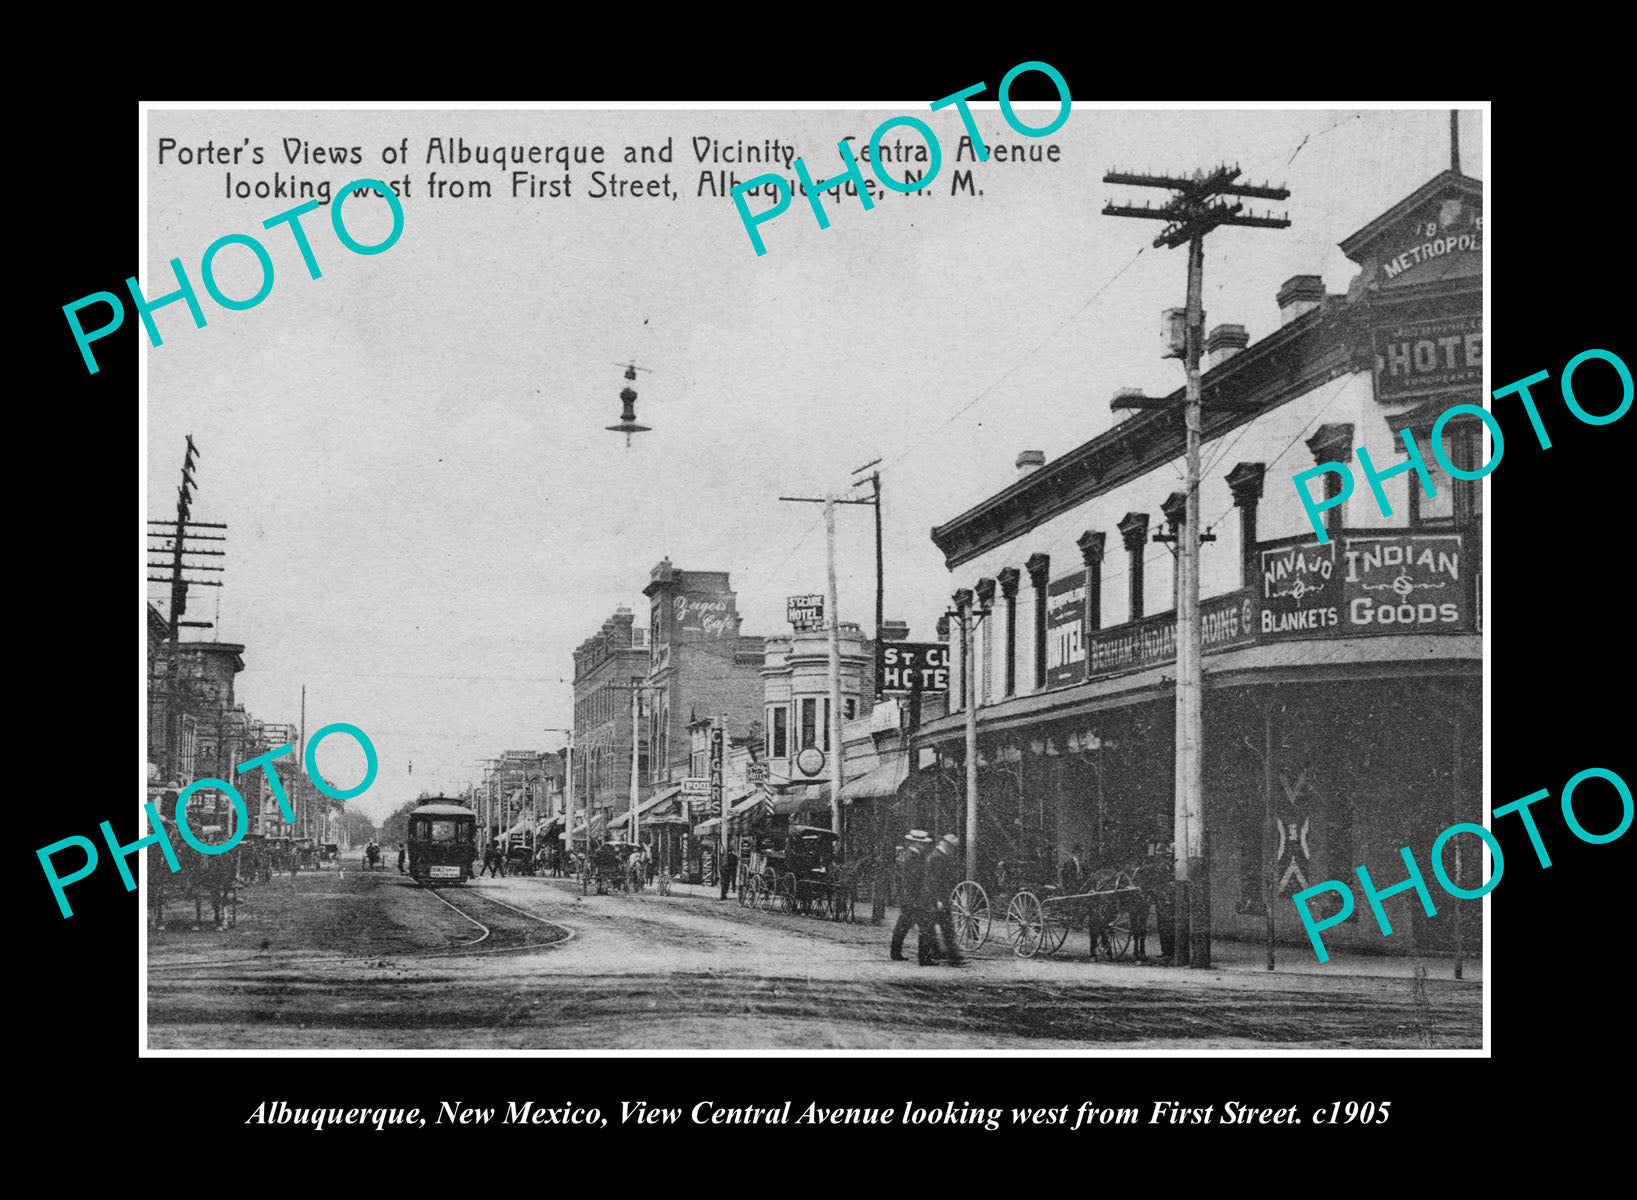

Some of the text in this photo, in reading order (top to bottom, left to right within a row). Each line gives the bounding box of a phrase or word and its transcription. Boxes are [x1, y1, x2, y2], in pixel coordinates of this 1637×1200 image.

[1384, 234, 1481, 279] METROPOL
[1387, 333, 1483, 376] HOTE
[1265, 551, 1333, 598] NAVAJO
[1345, 544, 1460, 583] INDIAN
[789, 607, 822, 622] HOTEL
[1191, 606, 1239, 647] ADING
[1261, 606, 1339, 634] BLANKETS
[1350, 597, 1460, 625] GOODS
[711, 730, 721, 815] CIGARS
